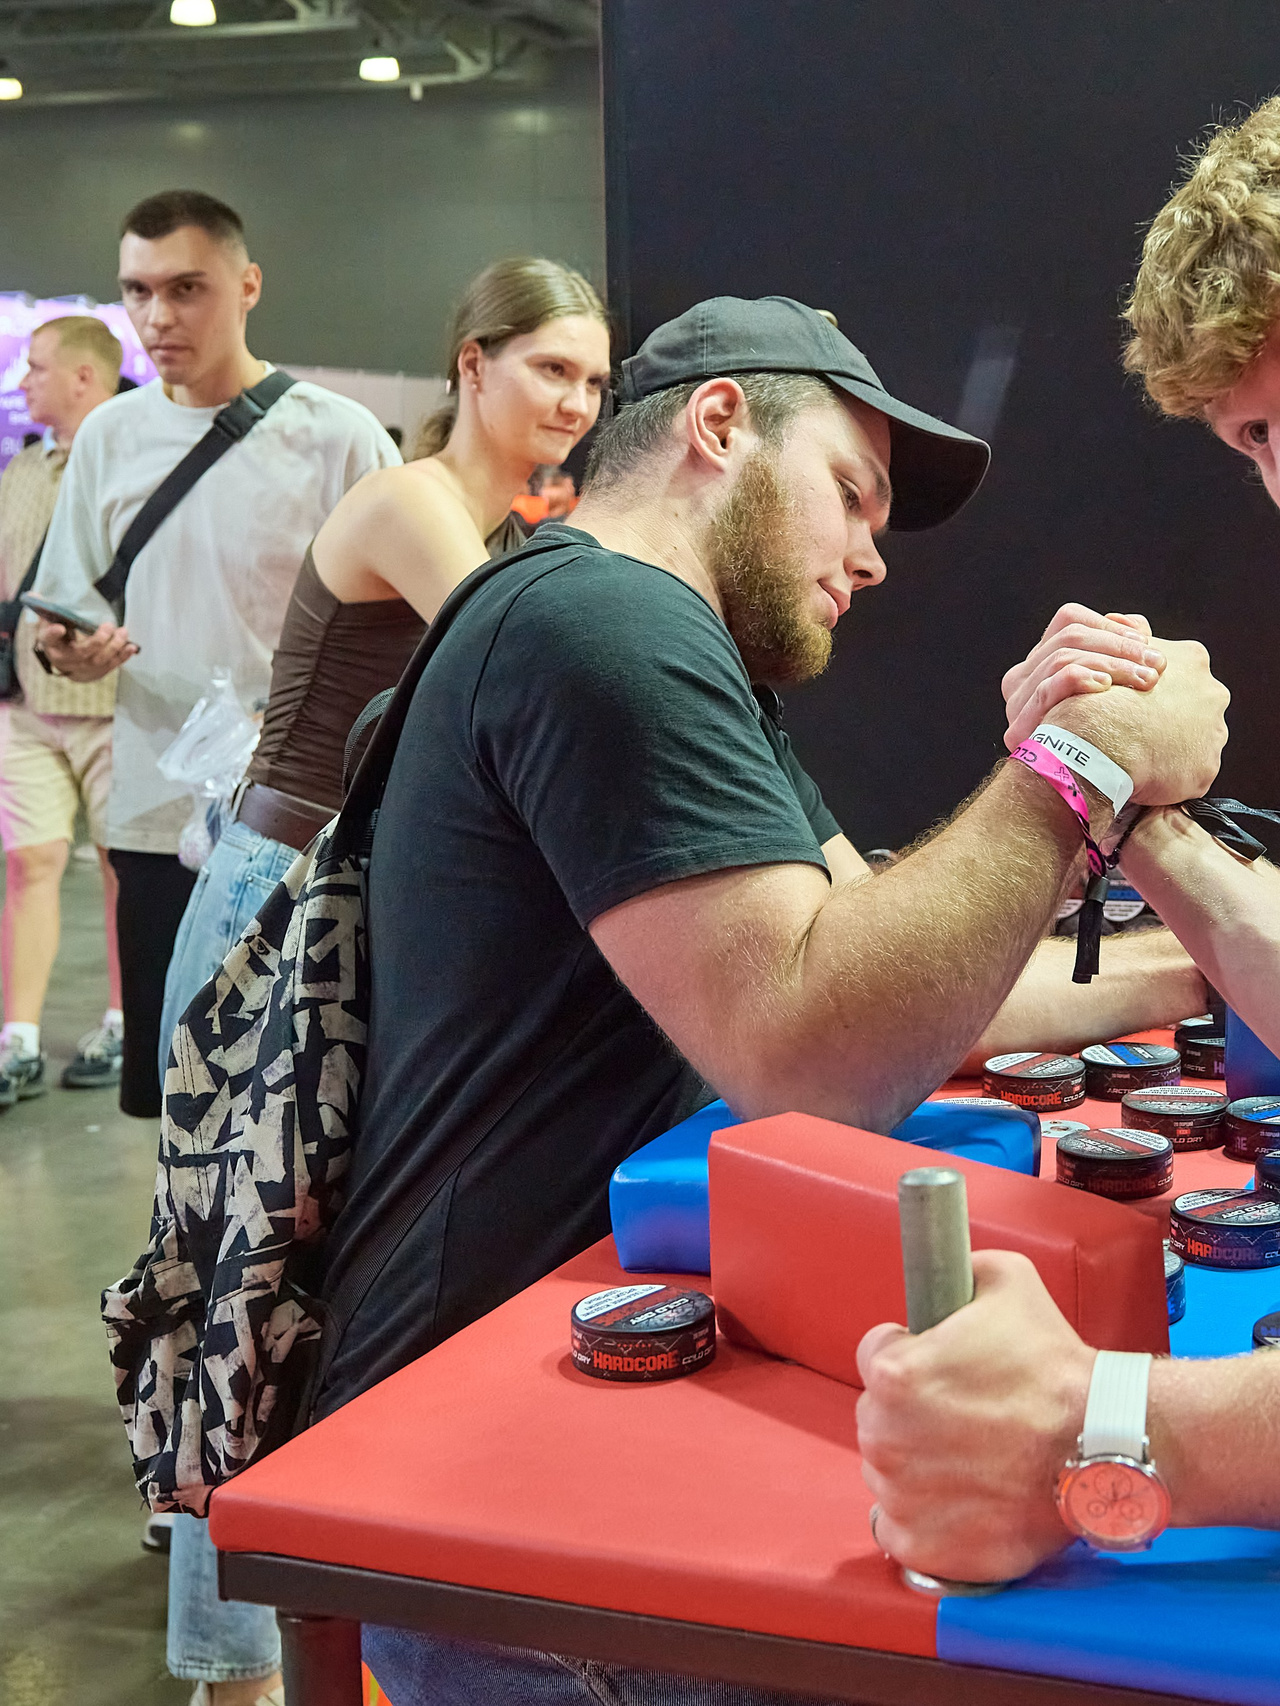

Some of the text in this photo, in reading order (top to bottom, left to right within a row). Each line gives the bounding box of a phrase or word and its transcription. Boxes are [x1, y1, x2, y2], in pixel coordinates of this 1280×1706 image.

[1031, 733, 1091, 767] GNITE
[1000, 1090, 1062, 1106] HARDCORE
[1187, 1237, 1262, 1261] HARDCORE
[655, 1297, 690, 1314] COLD
[629, 1311, 657, 1326] DRY
[577, 1352, 592, 1365] DRY
[593, 1349, 680, 1372] HARDCORE
